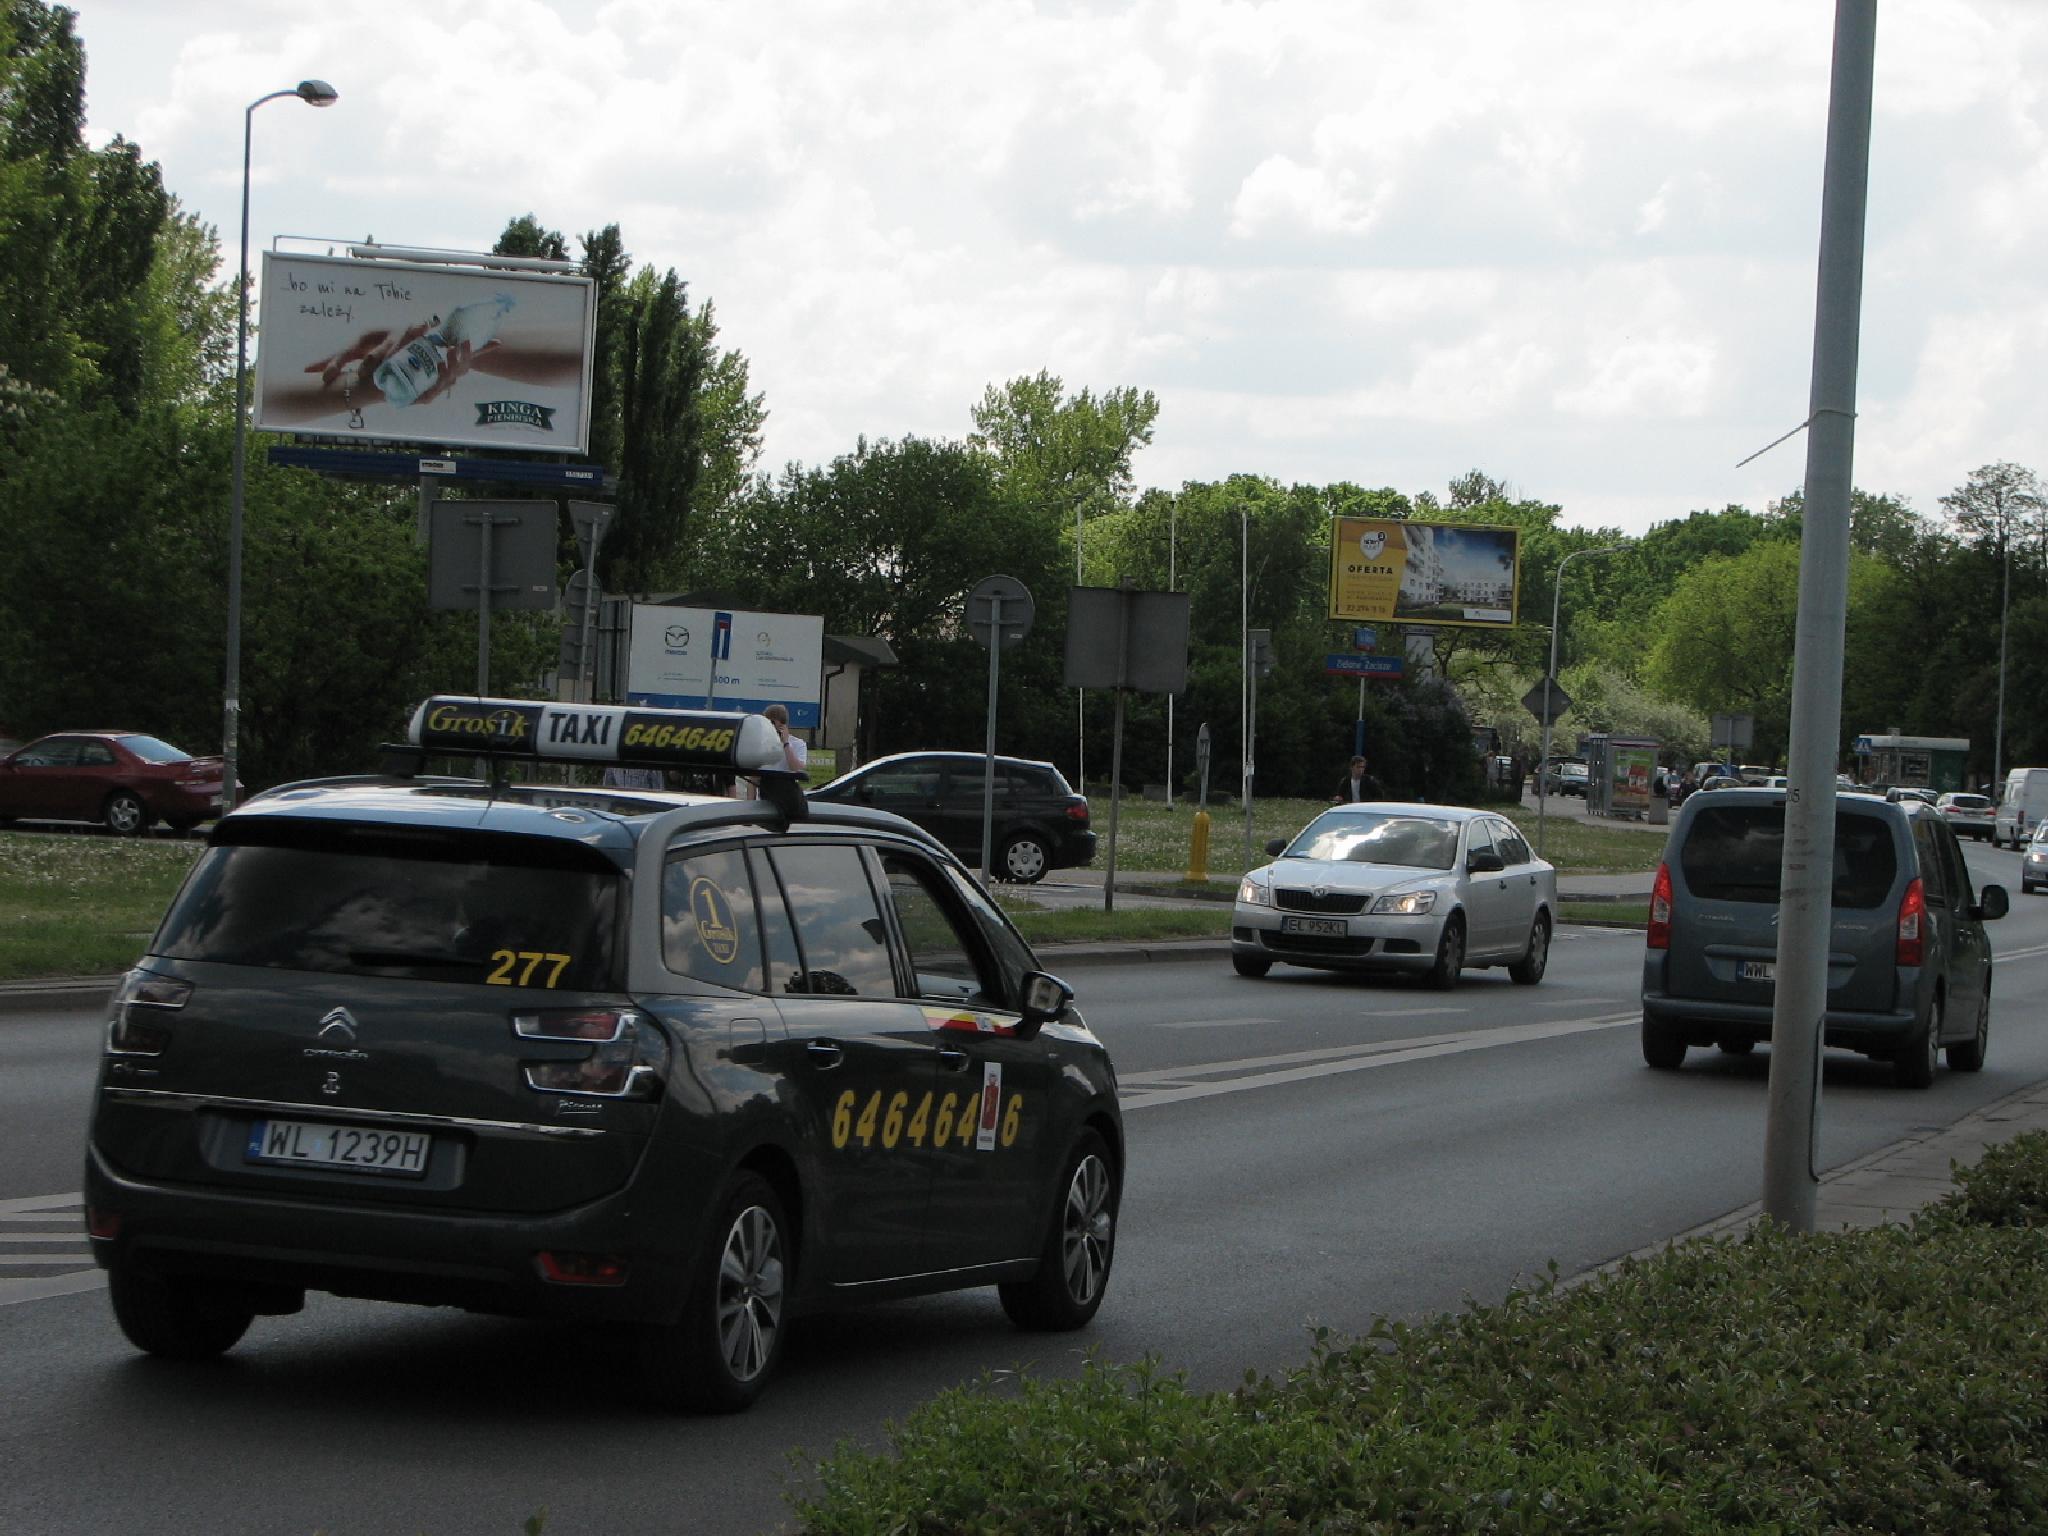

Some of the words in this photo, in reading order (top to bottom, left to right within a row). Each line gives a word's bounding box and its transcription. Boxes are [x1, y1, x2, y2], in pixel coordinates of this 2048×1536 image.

[487, 402, 543, 418] KINGA
[1347, 564, 1393, 575] OFERTA
[427, 705, 529, 739] Grosik
[548, 713, 612, 746] TAXI
[624, 723, 734, 752] 6464646
[1288, 919, 1305, 931] EL
[486, 950, 571, 989] 277
[1744, 962, 1771, 978] WWL
[267, 1124, 309, 1159] WL
[327, 1128, 425, 1169] 1239H
